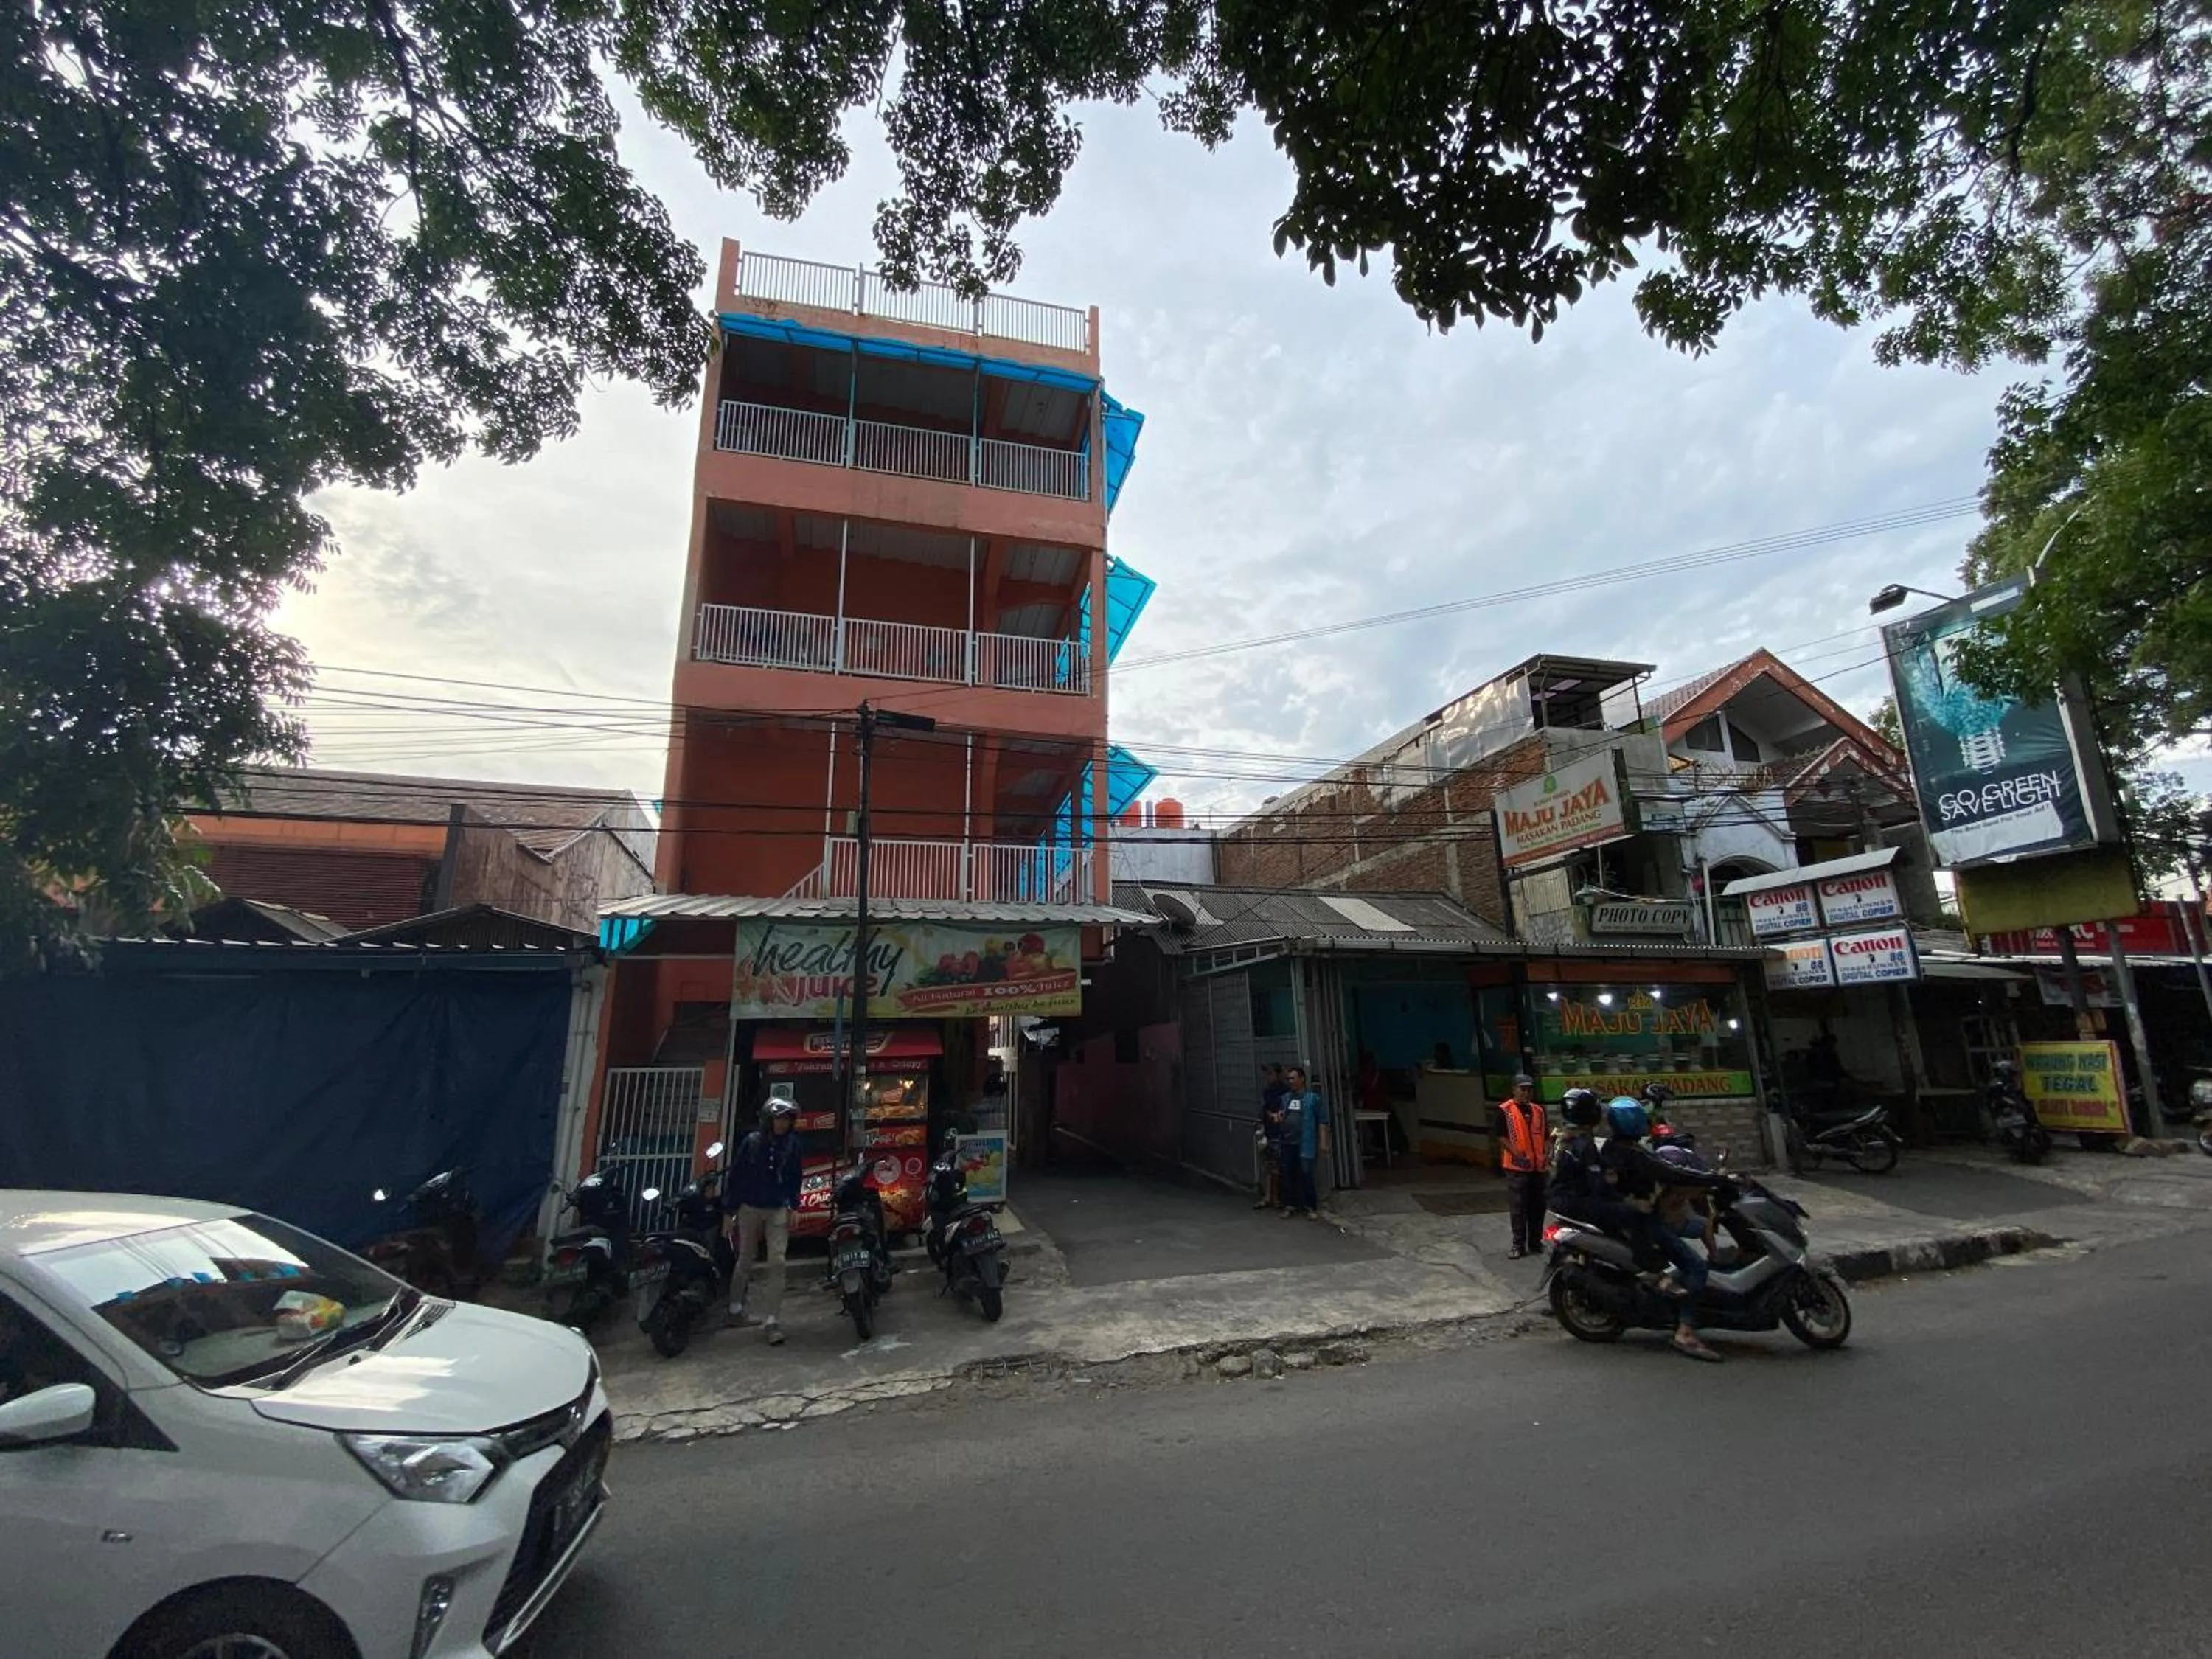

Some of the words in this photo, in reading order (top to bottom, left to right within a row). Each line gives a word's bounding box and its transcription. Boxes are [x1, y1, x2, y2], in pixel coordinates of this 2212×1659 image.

[1938, 789, 1976, 809] GO
[1982, 769, 2056, 800] GREEN
[1503, 807, 1555, 838] MAJU
[1559, 778, 1611, 818] JAYA
[1940, 796, 1995, 821] SAVE
[2000, 779, 2062, 809] LIGHT
[1517, 821, 1558, 844] MASAKAN
[1560, 809, 1602, 830] PADANG
[1821, 873, 1887, 897] Canon
[1750, 888, 1806, 908] Canon
[1598, 908, 1648, 923] PHOTO
[1652, 908, 1689, 924] COPY
[1862, 905, 1894, 917] COPIER
[1784, 917, 1812, 928] COPIER
[1834, 936, 1902, 955] Canon
[751, 922, 904, 997] healthy
[1798, 974, 1828, 984] COPIER
[1841, 971, 1874, 981] DIGITAL
[1875, 967, 1909, 977] COPIER
[982, 984, 1037, 997] 100%
[1560, 996, 1642, 1036] MAJU
[1651, 998, 1718, 1036] JAYA
[2042, 1074, 2099, 1093] TEGAL
